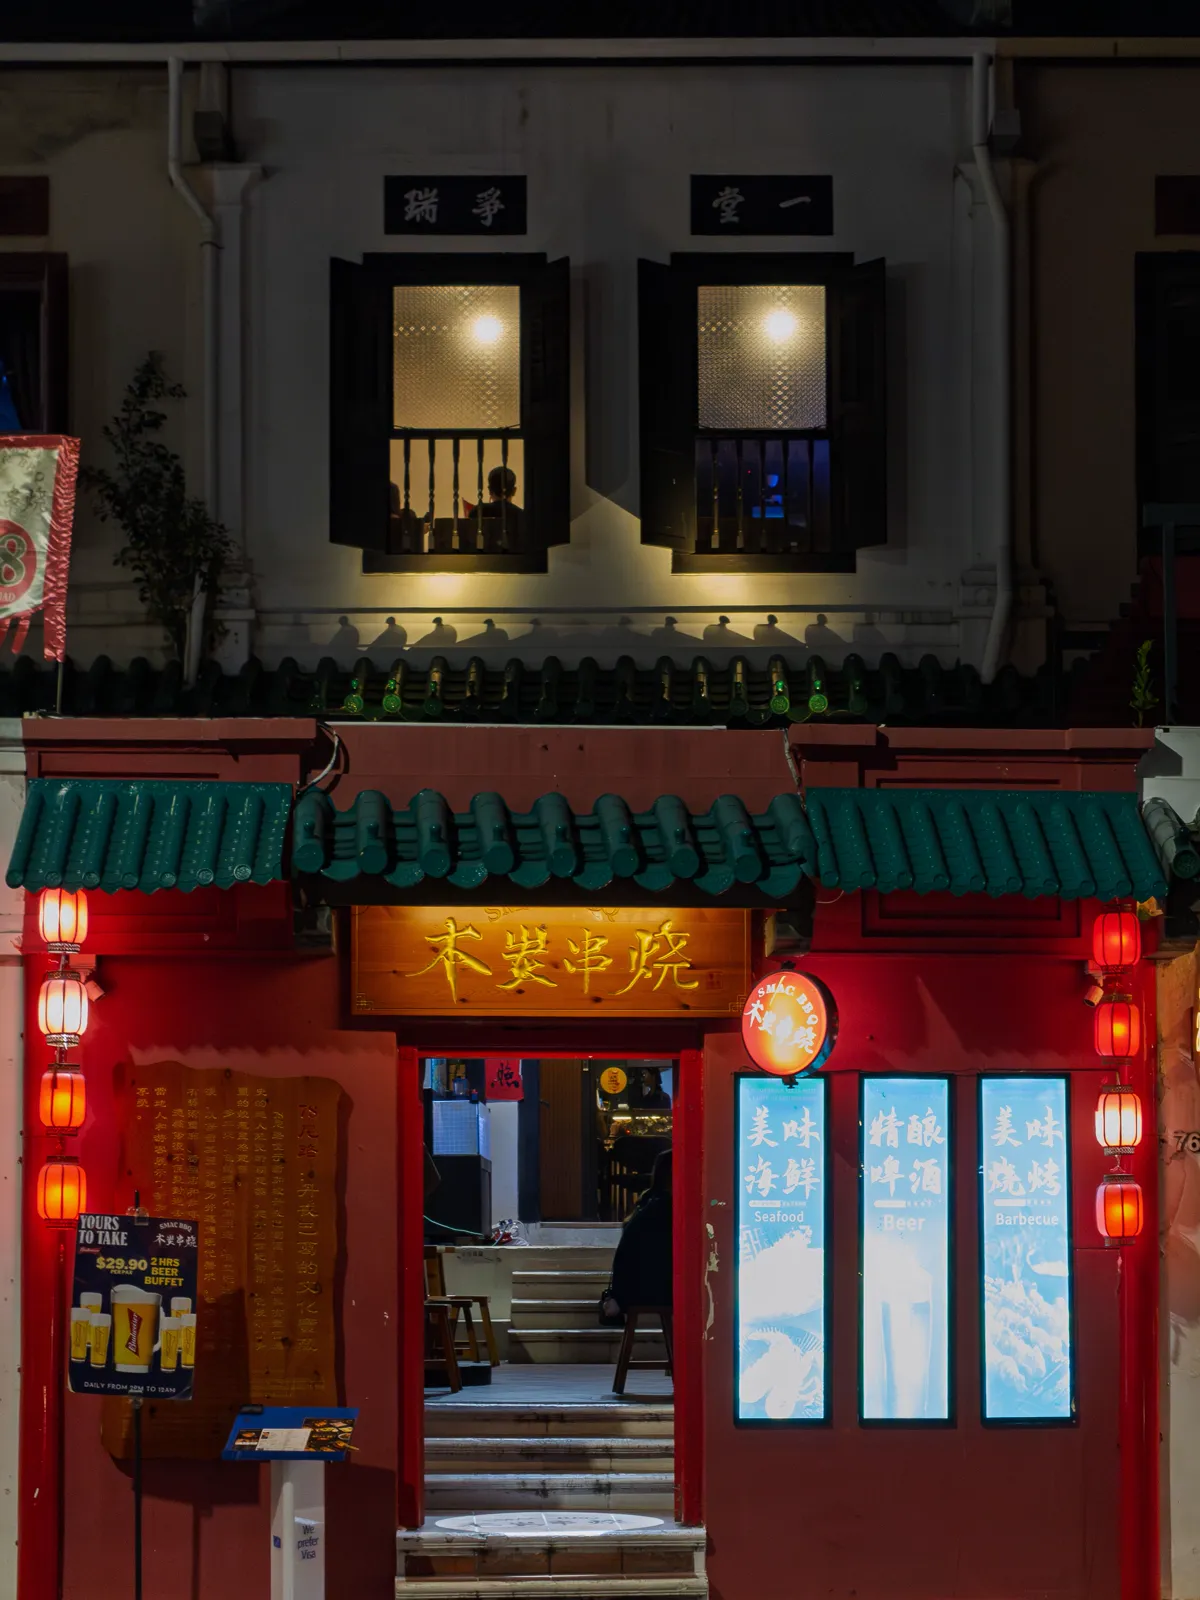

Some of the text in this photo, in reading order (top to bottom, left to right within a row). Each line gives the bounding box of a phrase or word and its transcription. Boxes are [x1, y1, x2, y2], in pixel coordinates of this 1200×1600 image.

[757, 982, 819, 1025] SMAC BBQ
[747, 1104, 821, 1149] 美味
[869, 1106, 946, 1149] 精酿
[990, 1105, 1064, 1148] 美味
[1174, 1132, 1200, 1153] 76
[744, 1153, 820, 1199] 海鲜
[868, 1154, 942, 1197] 啤酒
[987, 1155, 1062, 1197] 烧烤
[79, 1214, 120, 1231] YOURS
[754, 1210, 804, 1223] Seafood
[883, 1214, 926, 1231] Beer
[995, 1212, 1059, 1226] Barbecue
[159, 1221, 193, 1233] SMAC BBQ
[78, 1230, 129, 1247] TO TAKE
[96, 1256, 148, 1271] $29.90
[150, 1257, 180, 1267] 2 HRS
[151, 1267, 179, 1277] BEER
[144, 1276, 185, 1287] BUFFET
[84, 1381, 105, 1389] DAILY
[302, 1525, 315, 1535] We
[297, 1535, 319, 1550] prefer
[301, 1550, 316, 1560] Visa
